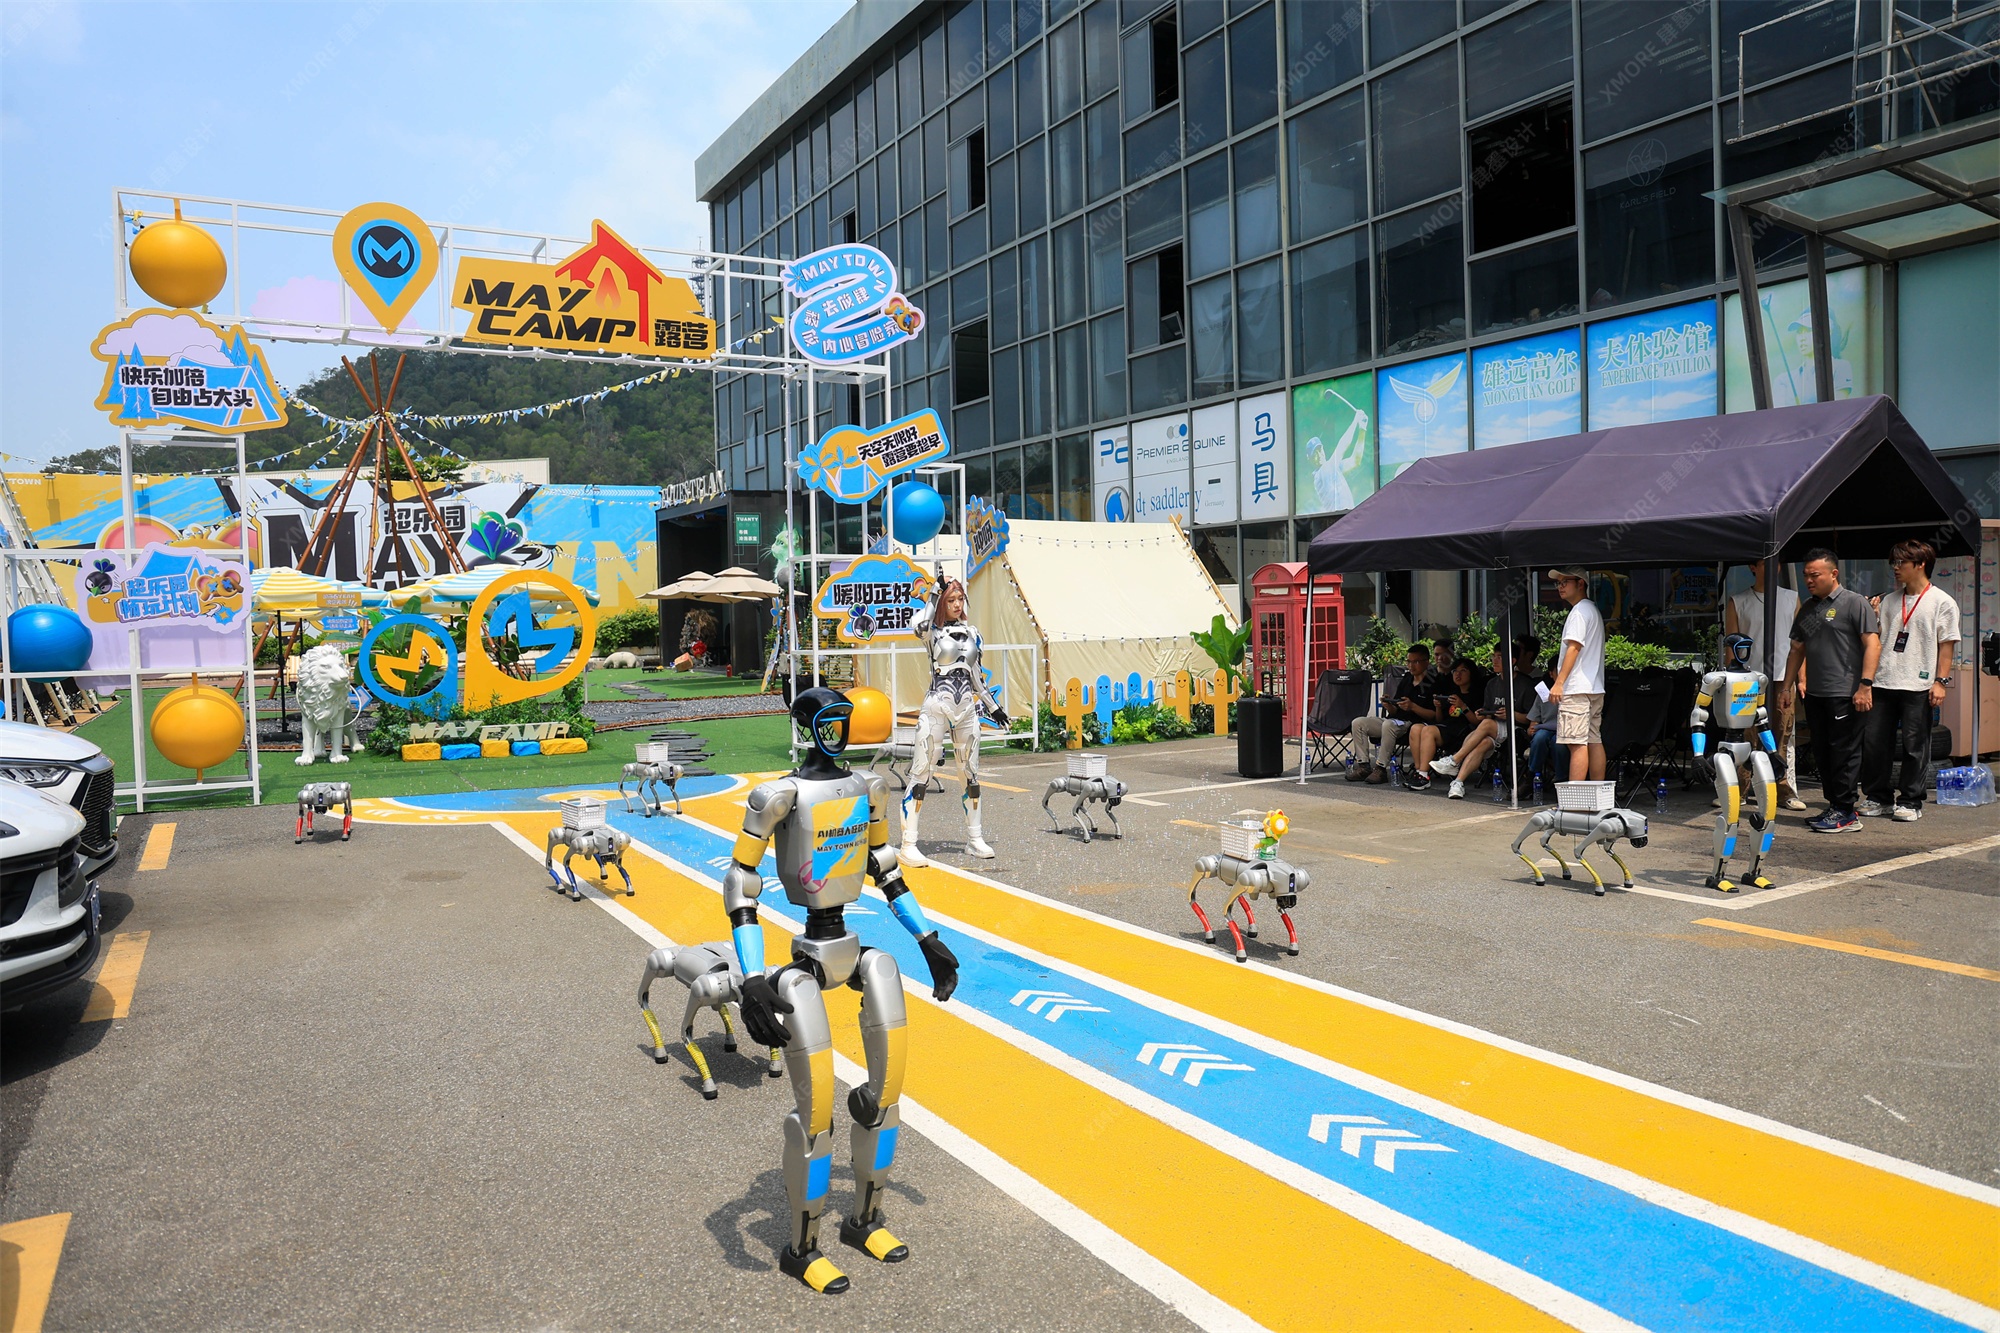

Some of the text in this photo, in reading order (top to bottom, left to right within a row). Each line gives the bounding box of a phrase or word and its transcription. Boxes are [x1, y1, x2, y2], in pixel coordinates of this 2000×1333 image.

[1619, 187, 1676, 209] KARL'S FIELD
[802, 254, 887, 294] MAY TOWN
[463, 278, 592, 312] MAY
[477, 308, 637, 343] CAMP
[654, 318, 709, 350] 露营
[1598, 321, 1713, 372] 夫体验馆
[121, 366, 205, 387] 快乐加倍
[1482, 348, 1578, 390] 雄远高尔
[1601, 354, 1712, 387] EXPERIENCE PAVILION
[151, 387, 254, 408] 自由占大头
[1483, 377, 1578, 407] XIONGYUAN GOLF
[857, 426, 918, 460] 天空无限好
[881, 433, 942, 468] 露营要趁早
[1136, 441, 1180, 461] PREMIER
[1251, 412, 1279, 504] 马具
[1150, 486, 1202, 512] saddlery
[126, 575, 189, 597] 超乐园
[833, 582, 912, 606] 暖阳正好
[118, 590, 201, 619] 畅玩计划
[875, 606, 921, 629] 去浪
[409, 720, 571, 743] MAY CAMP
[816, 845, 833, 853] MAY
[835, 841, 854, 851] TOWN
